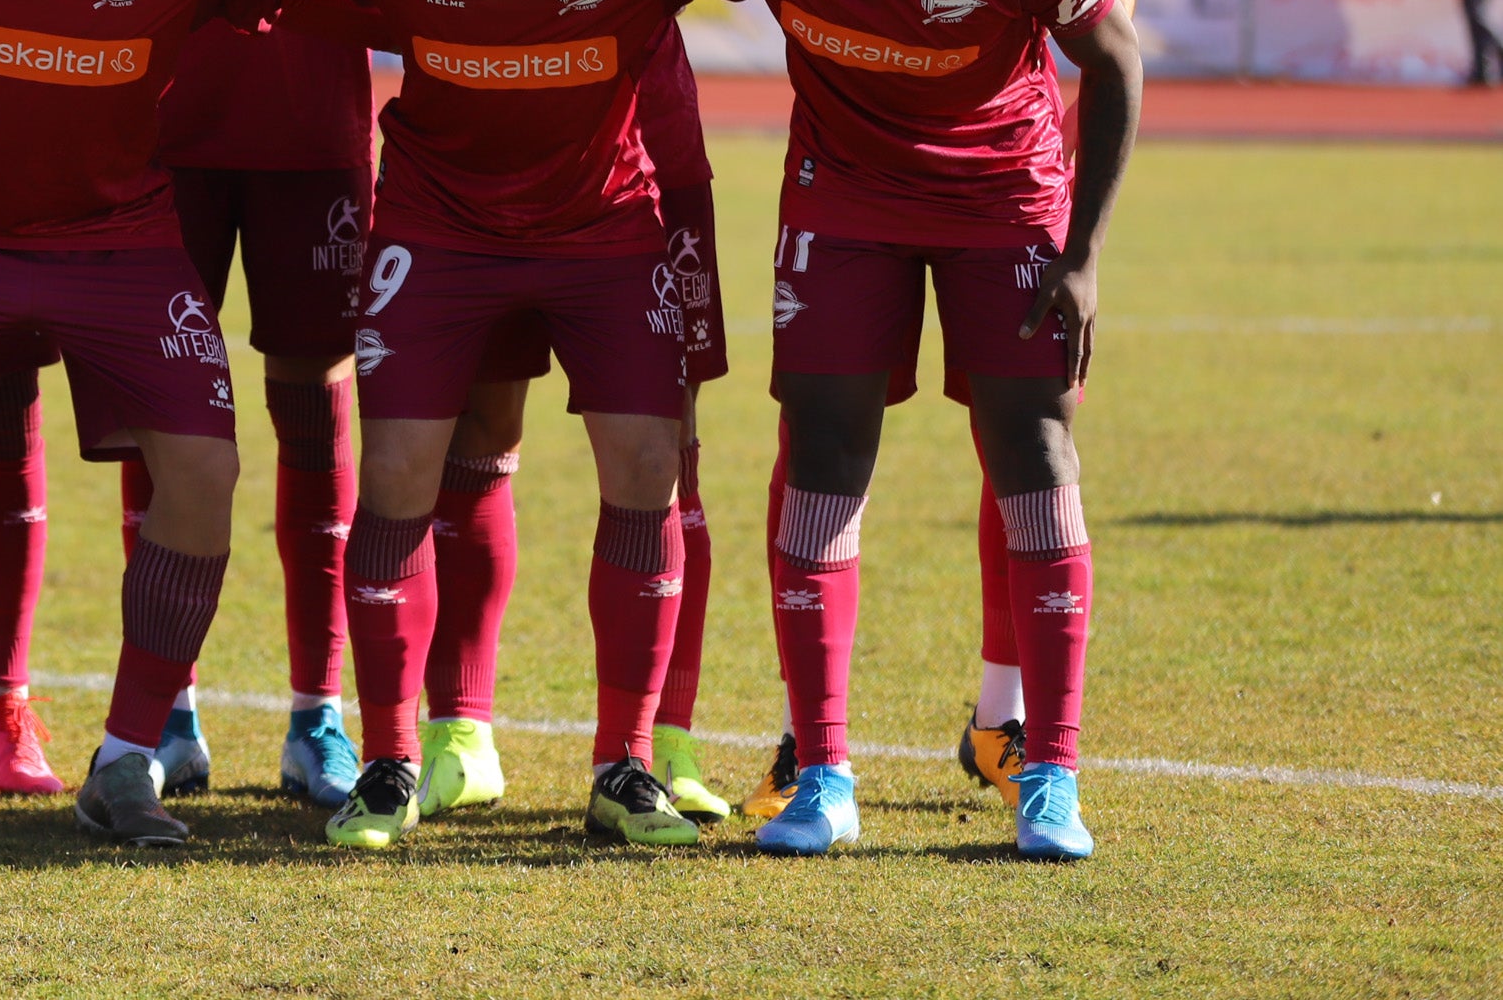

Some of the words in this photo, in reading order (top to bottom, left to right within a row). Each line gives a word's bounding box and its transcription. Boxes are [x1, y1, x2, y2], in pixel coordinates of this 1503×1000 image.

[791, 18, 931, 70] euskaltel
[426, 51, 570, 78] euskaltel
[364, 245, 413, 317] 9
[1033, 606, 1084, 614] KELME
